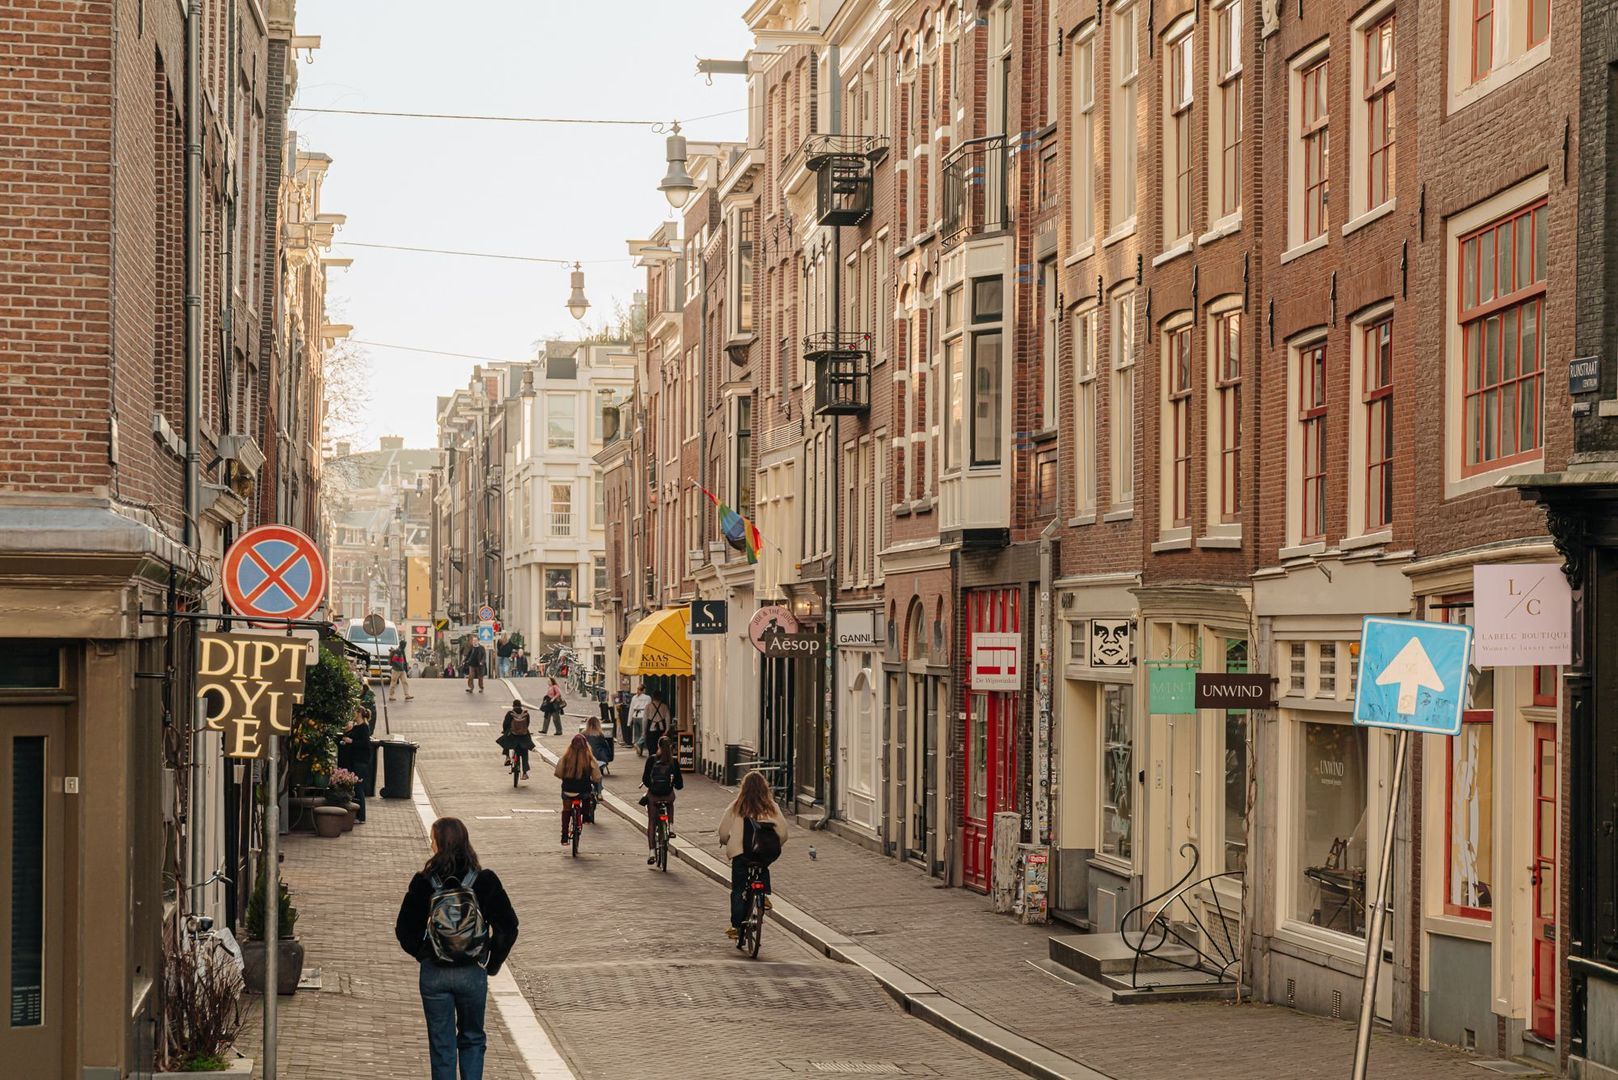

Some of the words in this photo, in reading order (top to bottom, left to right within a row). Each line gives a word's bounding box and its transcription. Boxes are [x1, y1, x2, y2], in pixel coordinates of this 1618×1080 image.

[840, 633, 872, 643] GANNI
[1521, 632, 1568, 640] BOUTIQUE
[198, 637, 307, 682] DIPT
[641, 654, 669, 663] KAAS
[1203, 684, 1263, 698] UNWIND
[1320, 759, 1344, 777] UNWIND
